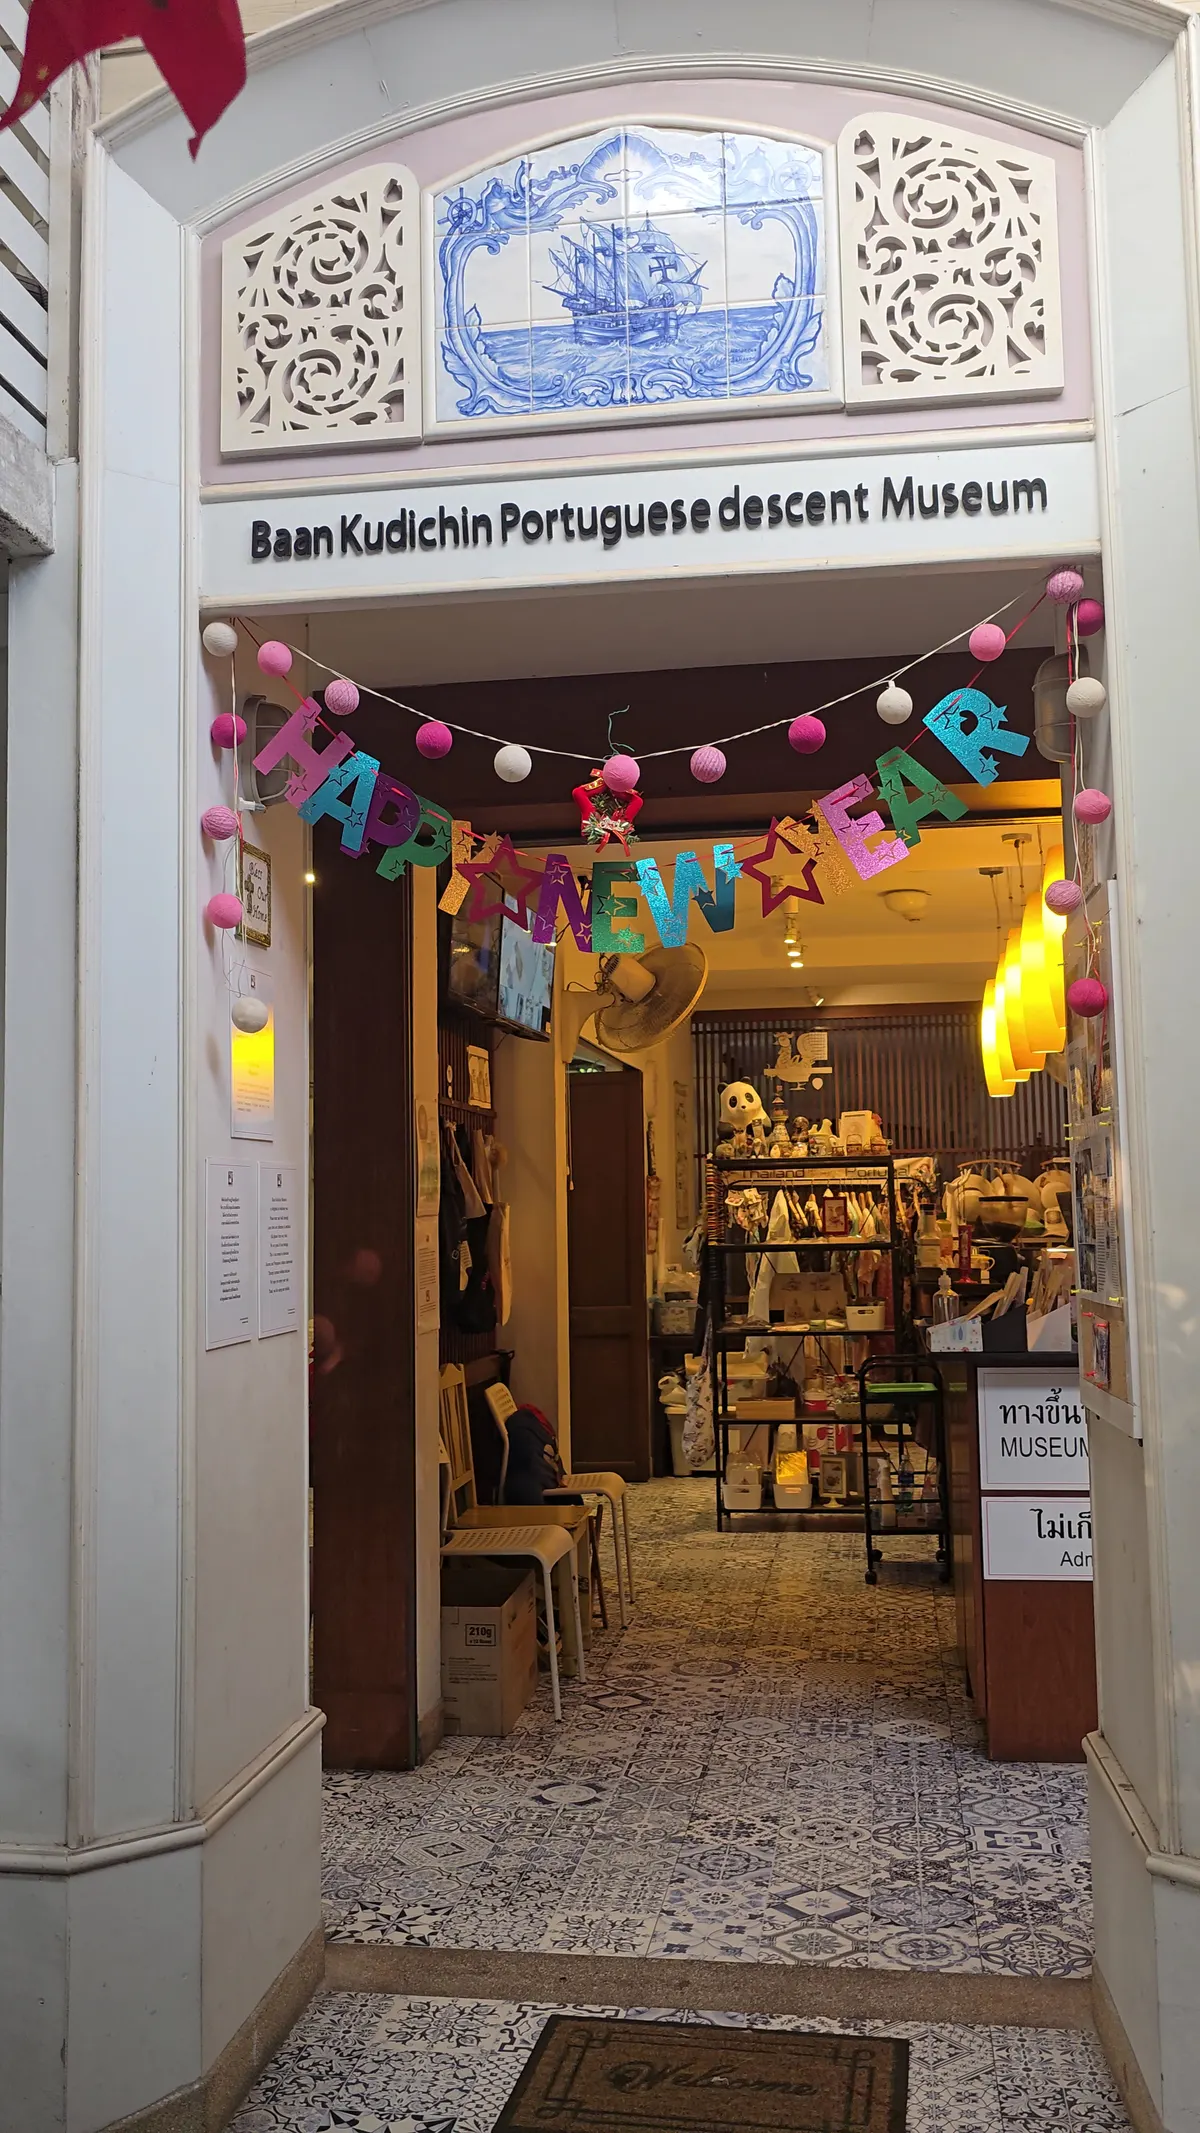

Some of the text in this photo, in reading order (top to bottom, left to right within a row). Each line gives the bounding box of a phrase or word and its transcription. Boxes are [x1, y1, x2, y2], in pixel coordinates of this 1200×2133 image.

[252, 476, 1049, 563] Baan Kudichin Portuguese descent Museum
[532, 842, 744, 954] NEW
[773, 687, 1031, 896] YEAR
[741, 1165, 912, 1180] Thailand Portual
[468, 1626, 493, 1638] 210g
[607, 2060, 819, 2097] Welcome
